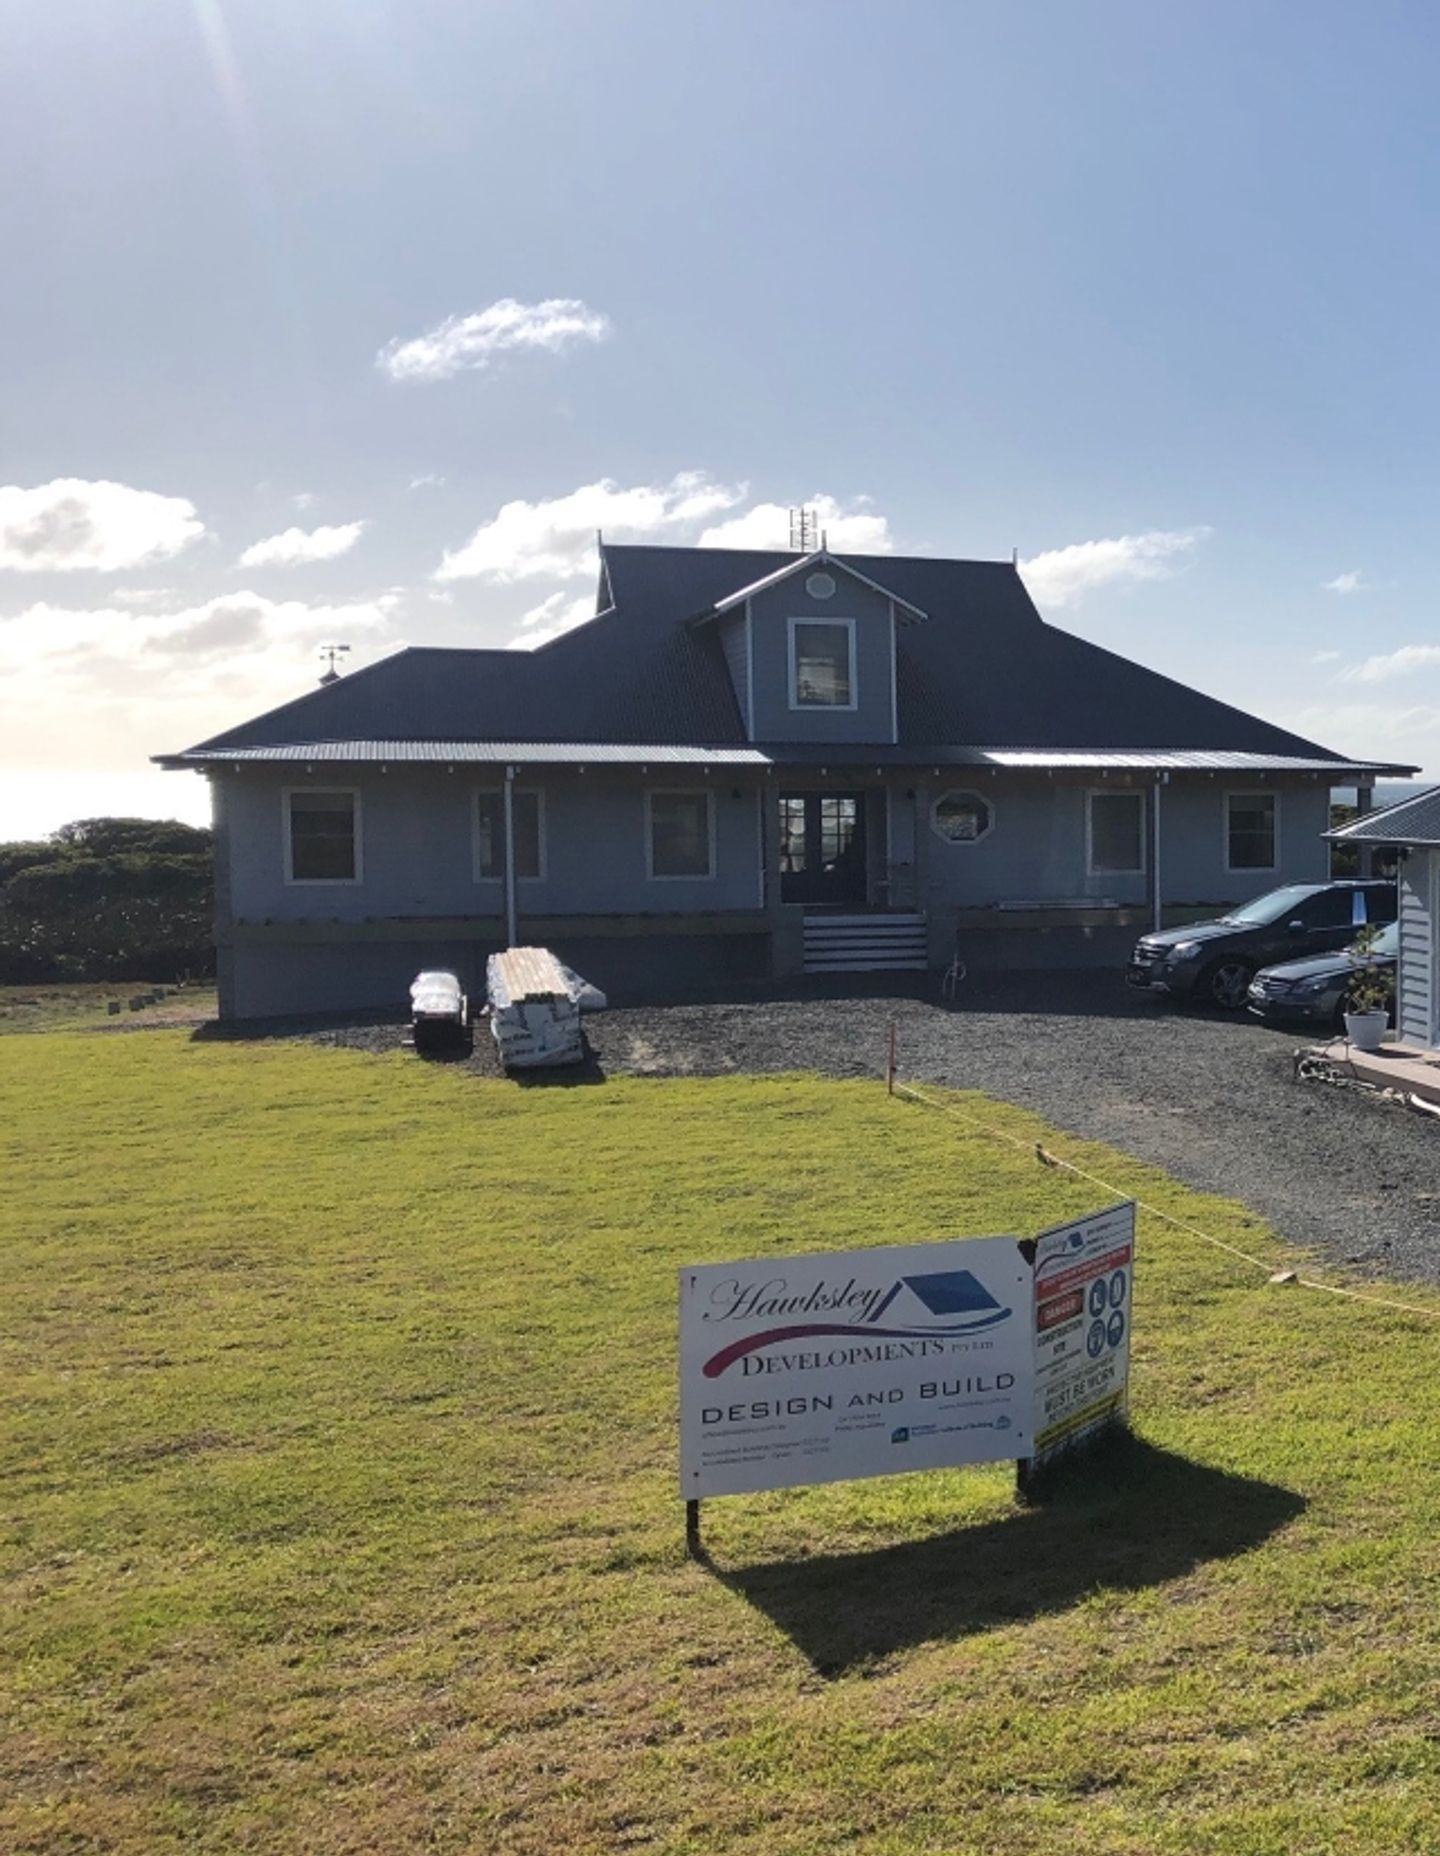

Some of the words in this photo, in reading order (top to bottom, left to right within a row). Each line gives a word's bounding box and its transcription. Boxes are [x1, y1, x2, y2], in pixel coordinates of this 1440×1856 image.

[702, 1278, 884, 1324] Hawksley
[742, 1338, 945, 1377] DEVELOPMENTS
[701, 1394, 833, 1424] DESIGN
[848, 1387, 905, 1408] AND
[919, 1373, 1015, 1399] BUILD
